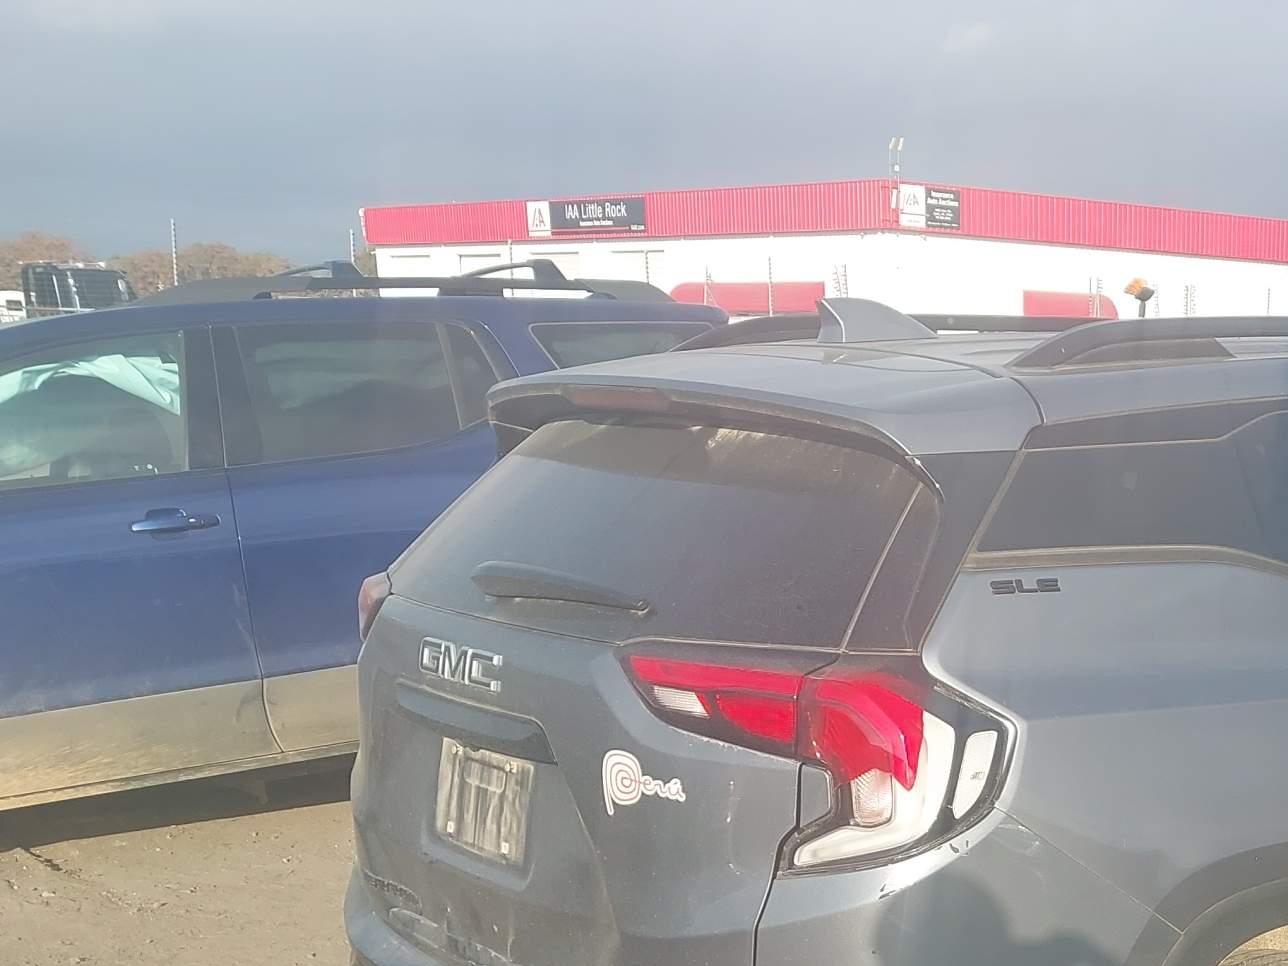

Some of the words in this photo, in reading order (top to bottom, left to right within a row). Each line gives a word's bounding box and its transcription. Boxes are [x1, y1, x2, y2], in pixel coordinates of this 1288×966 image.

[565, 204, 579, 219] IAA
[581, 202, 602, 218] Little
[605, 201, 627, 217] Rock
[990, 577, 1061, 595] SLE
[419, 636, 503, 693] GMC
